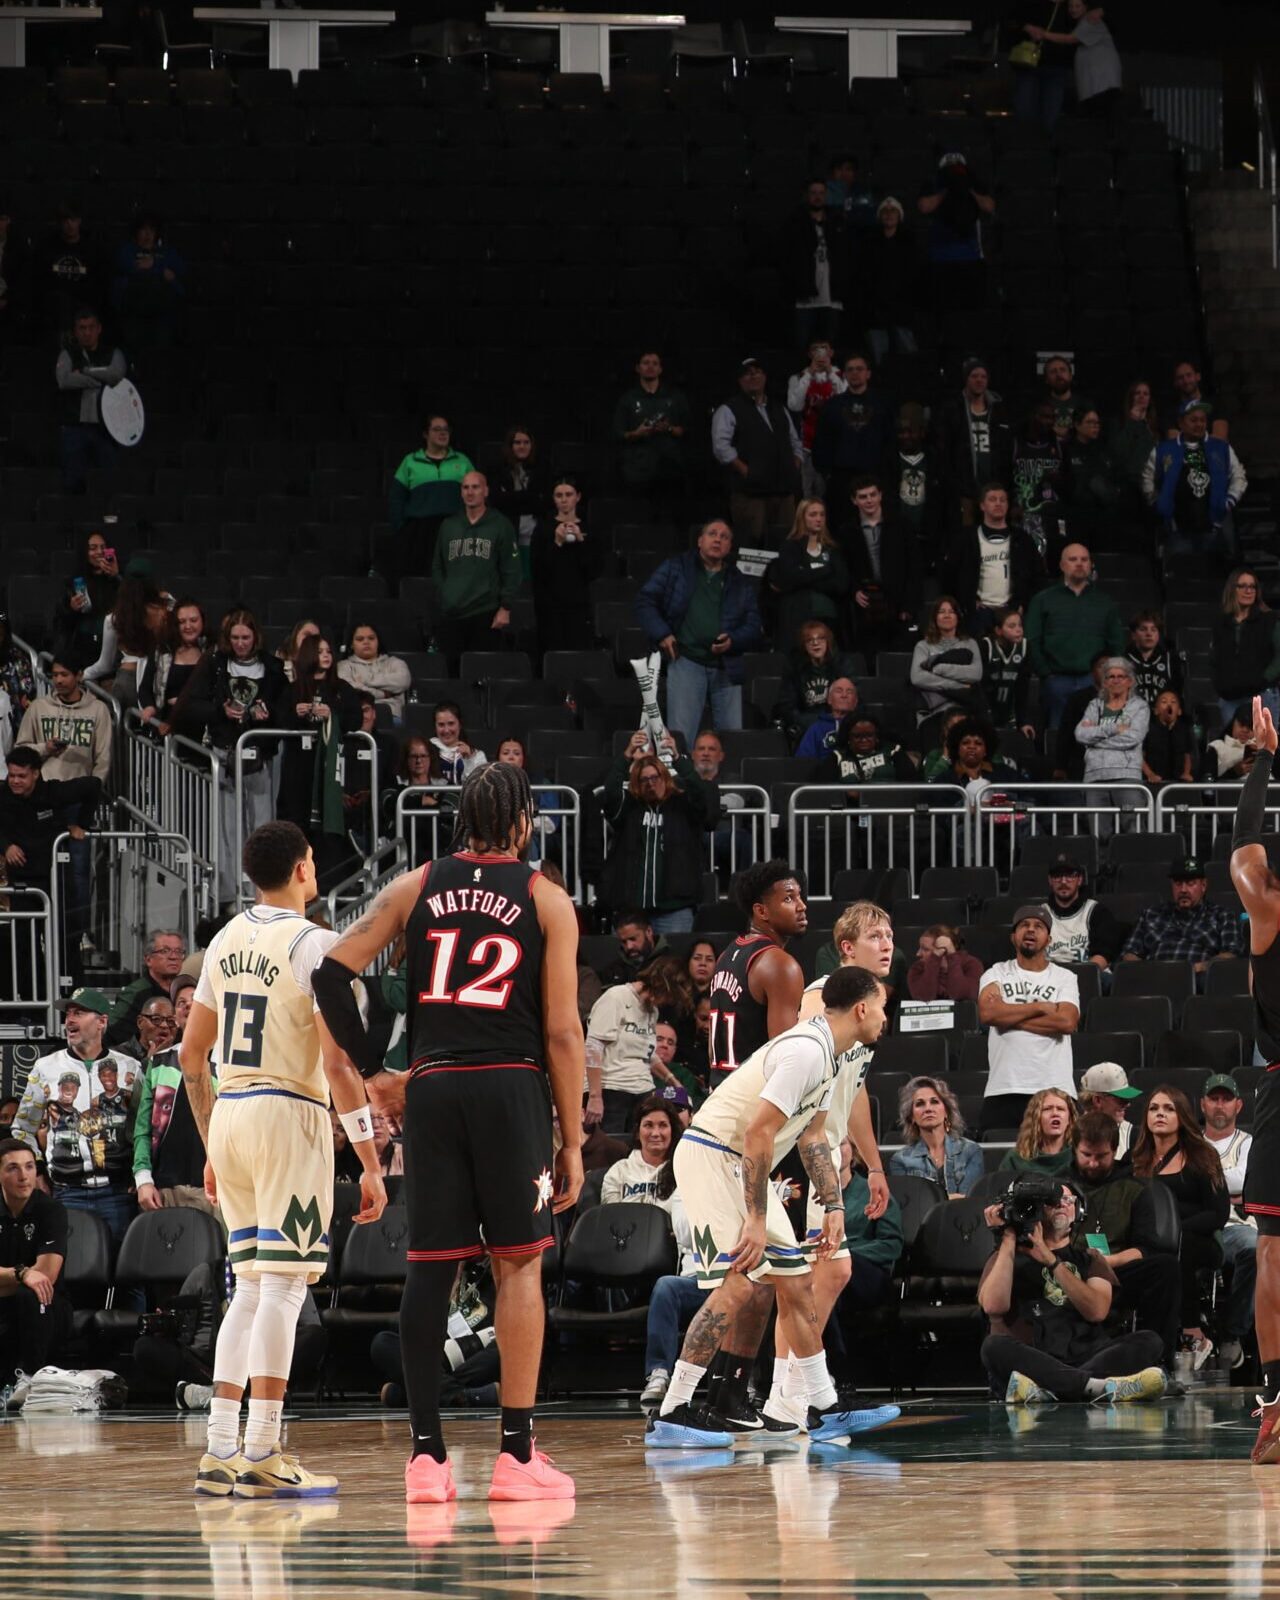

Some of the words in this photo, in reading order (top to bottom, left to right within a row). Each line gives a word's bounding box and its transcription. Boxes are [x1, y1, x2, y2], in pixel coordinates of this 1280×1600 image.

[1136, 672, 1167, 688] UCKS
[426, 888, 522, 926] WATFORD
[219, 950, 280, 987] ROLLINS
[418, 928, 524, 1010] 12
[710, 970, 743, 1003] EDWARDS
[1003, 981, 1056, 1000] BUCKS
[223, 991, 268, 1068] 13
[709, 1009, 742, 1072] 11
